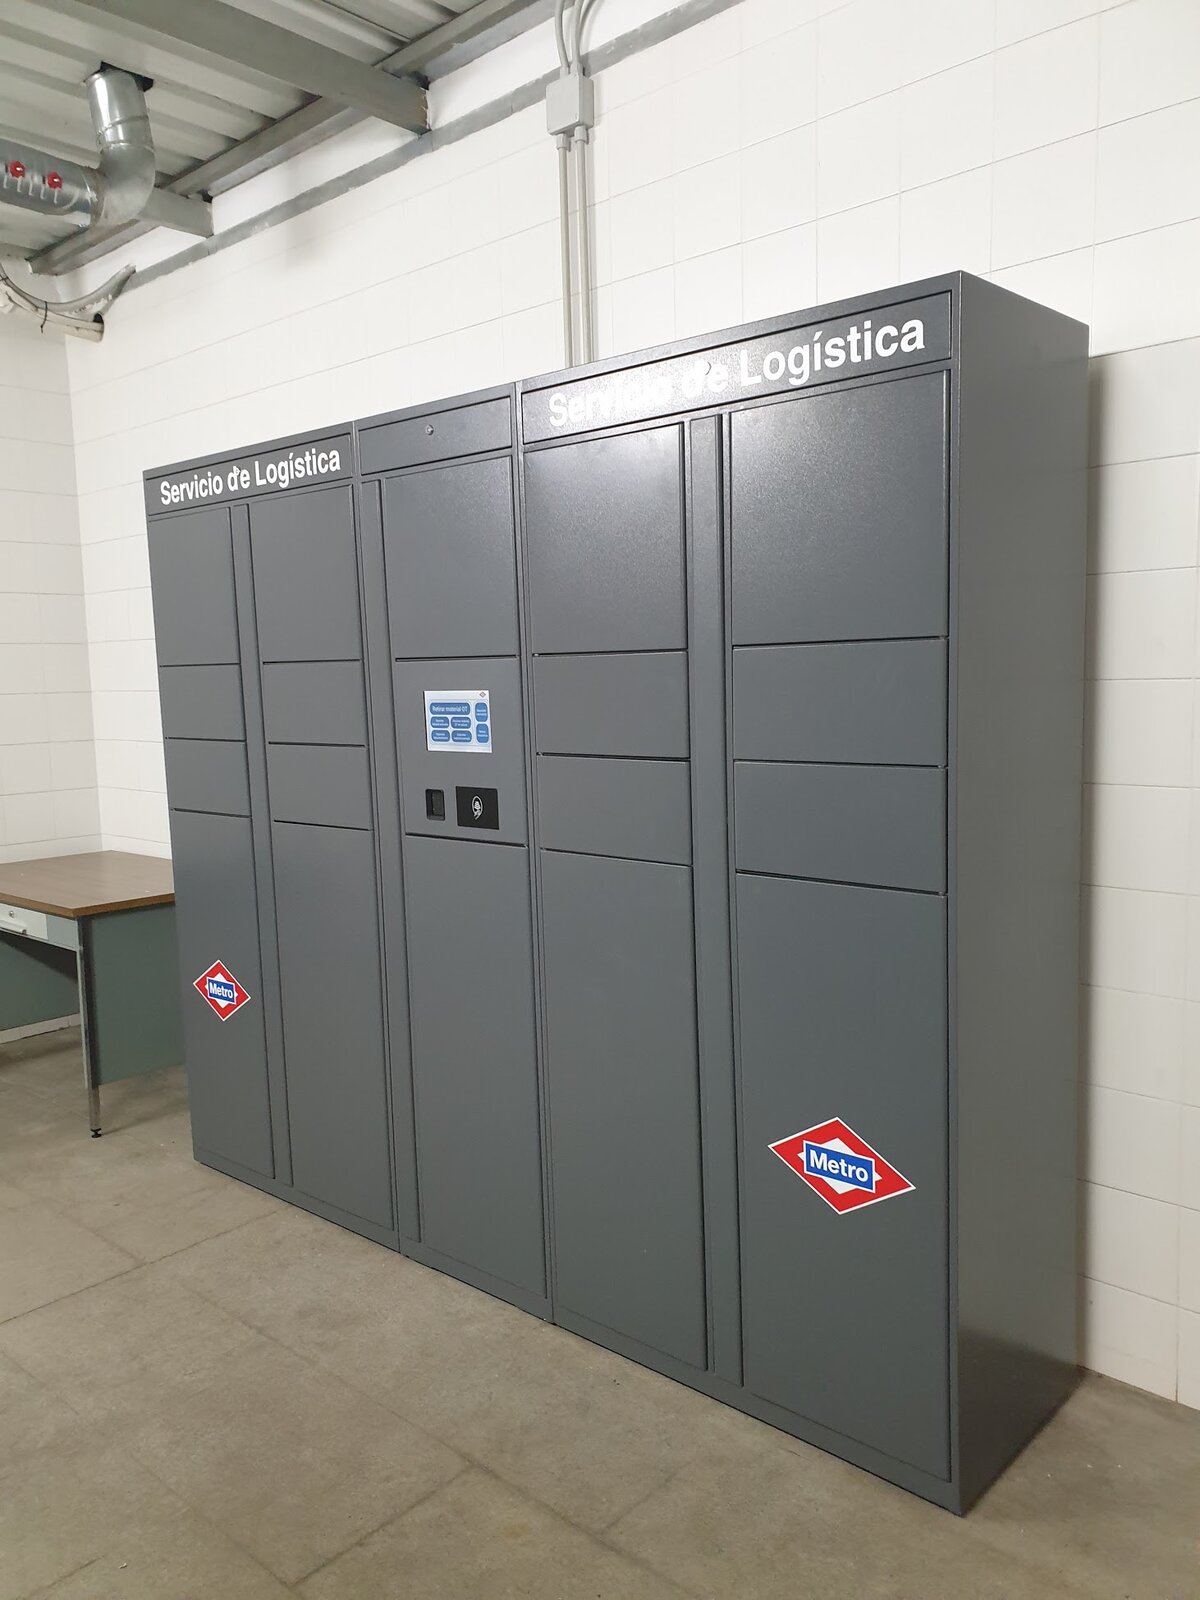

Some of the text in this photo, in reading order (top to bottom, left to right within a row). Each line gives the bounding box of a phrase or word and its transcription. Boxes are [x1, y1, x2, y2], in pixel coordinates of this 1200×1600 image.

[549, 318, 926, 427] Servicio de Logística
[160, 448, 341, 505] Servicio de Logística
[209, 982, 234, 999] Metro
[809, 1149, 869, 1182] Metro
